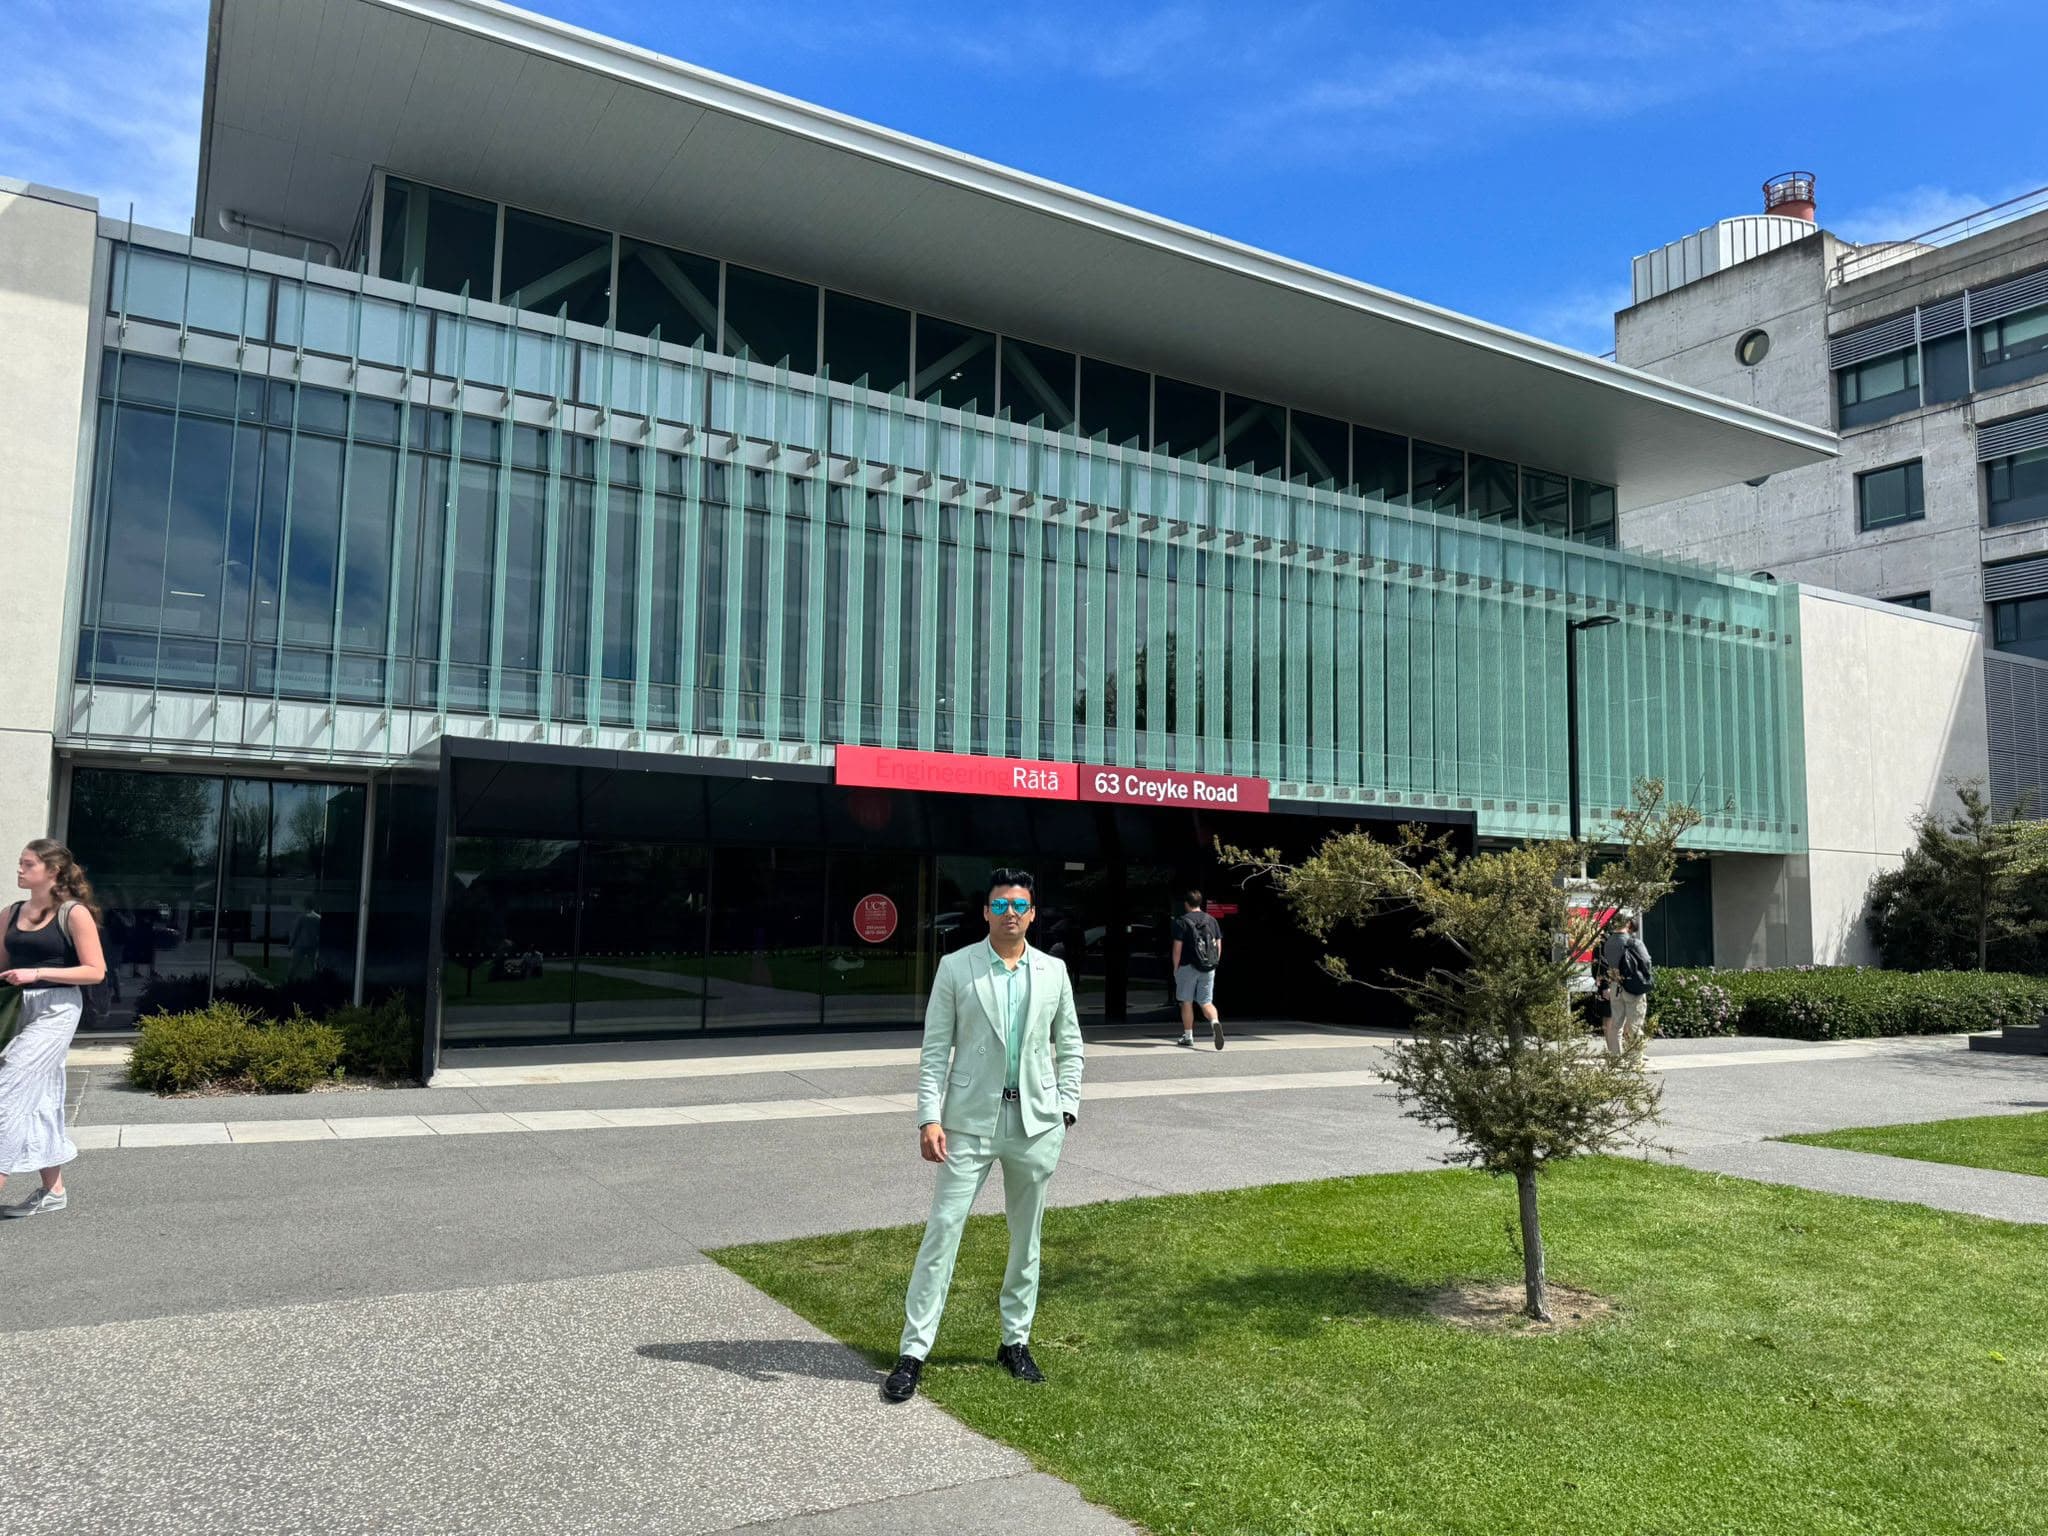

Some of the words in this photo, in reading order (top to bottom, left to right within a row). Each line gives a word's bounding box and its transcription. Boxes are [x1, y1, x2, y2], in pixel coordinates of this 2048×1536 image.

[875, 756, 1010, 791] Engineering
[1013, 766, 1059, 791] Rātā
[1094, 772, 1120, 795] 63
[1125, 774, 1188, 802] Creyke
[1193, 780, 1238, 803] Road
